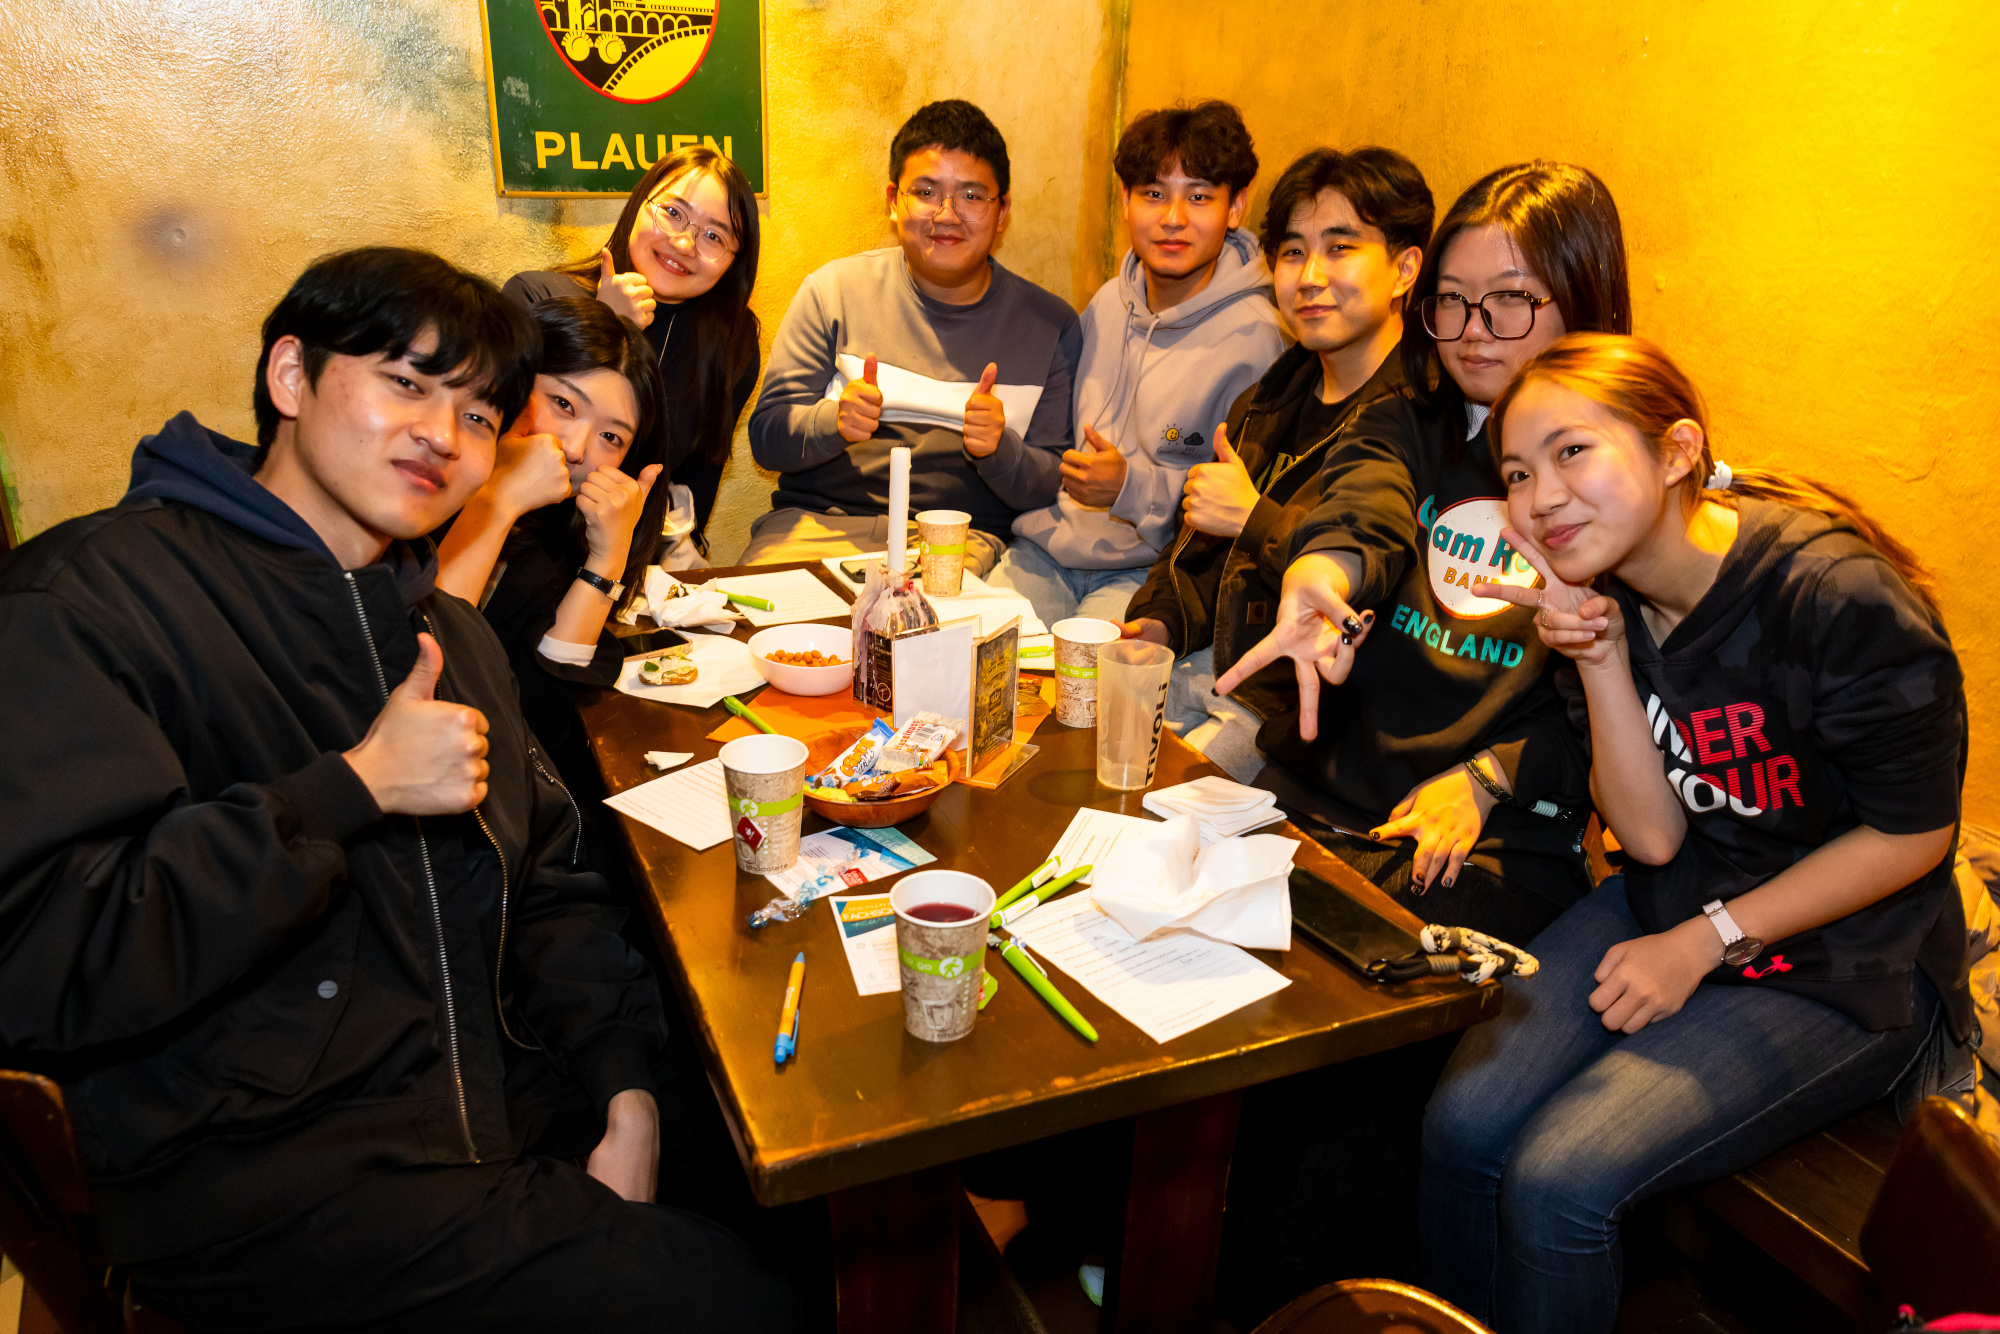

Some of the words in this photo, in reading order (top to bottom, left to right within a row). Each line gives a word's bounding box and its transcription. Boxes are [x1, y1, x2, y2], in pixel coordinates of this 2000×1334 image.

[1390, 603, 1524, 668] ENGLAND
[1070, 667, 1080, 676] to
[1082, 669, 1094, 677] go
[745, 863, 788, 873] chocolate
[916, 961, 932, 971] go
